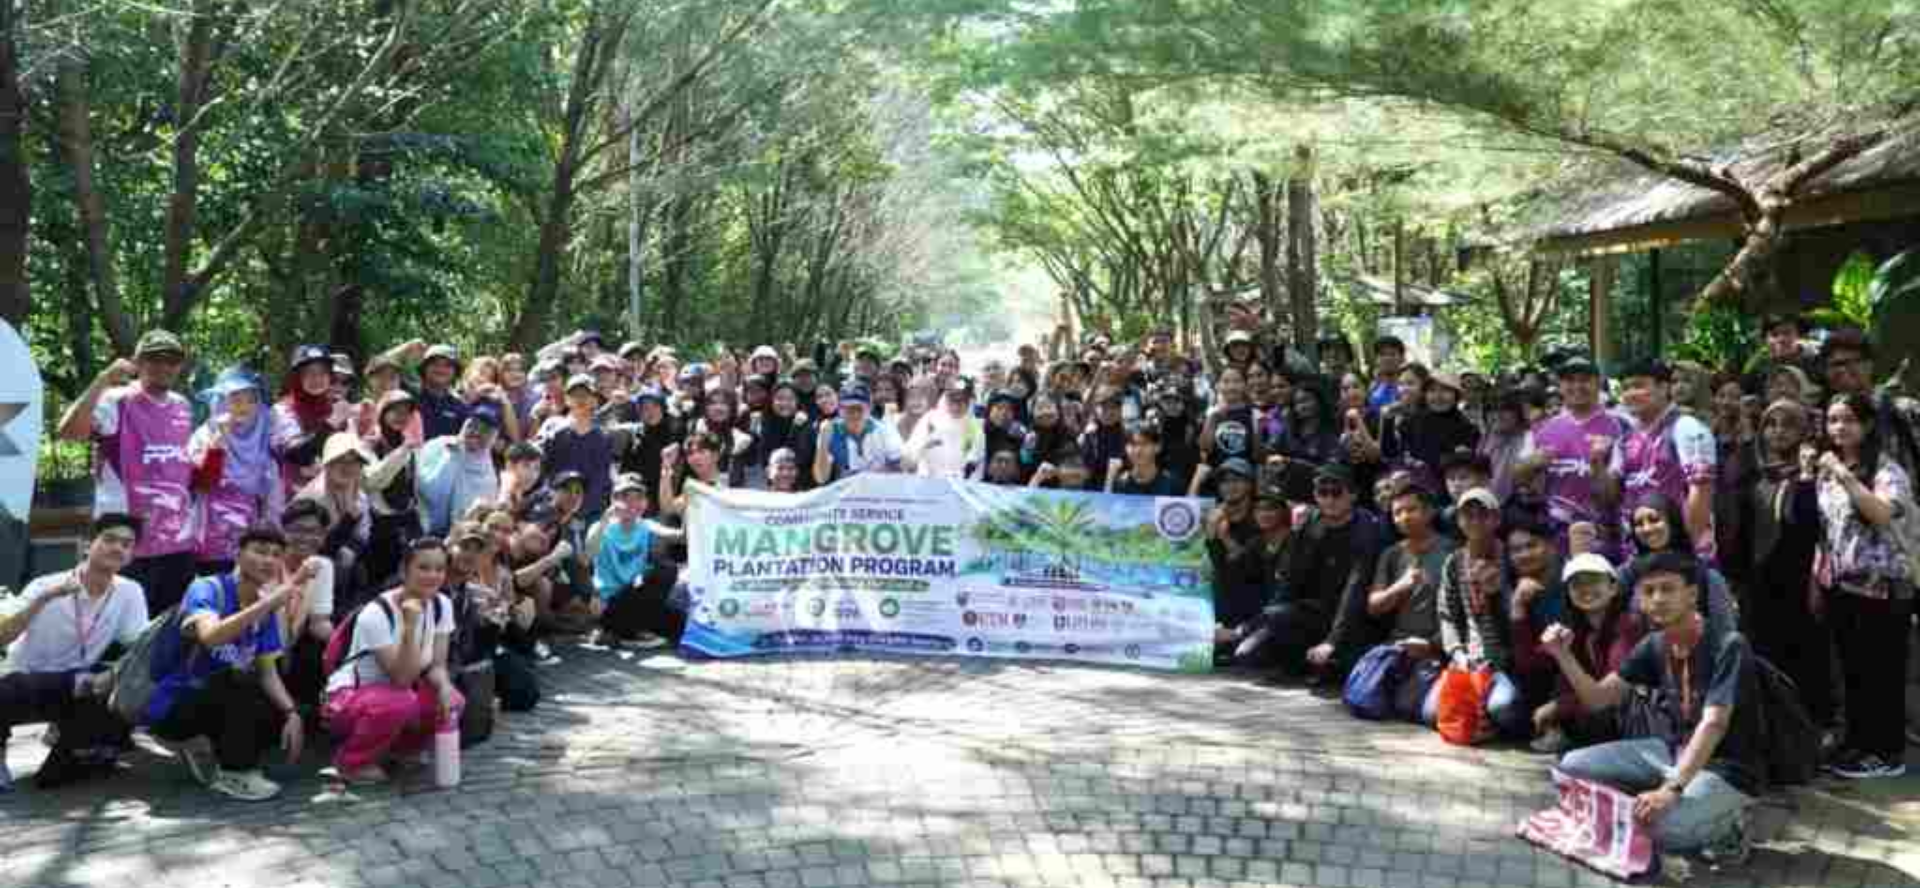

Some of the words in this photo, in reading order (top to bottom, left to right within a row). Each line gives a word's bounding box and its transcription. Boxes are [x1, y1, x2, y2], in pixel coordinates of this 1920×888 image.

[764, 508, 847, 525] COMMITY
[850, 508, 905, 521] SERVICE
[713, 523, 954, 556] MANGROVE
[713, 557, 844, 576] PLANTATION
[851, 555, 956, 577] PROGRAM
